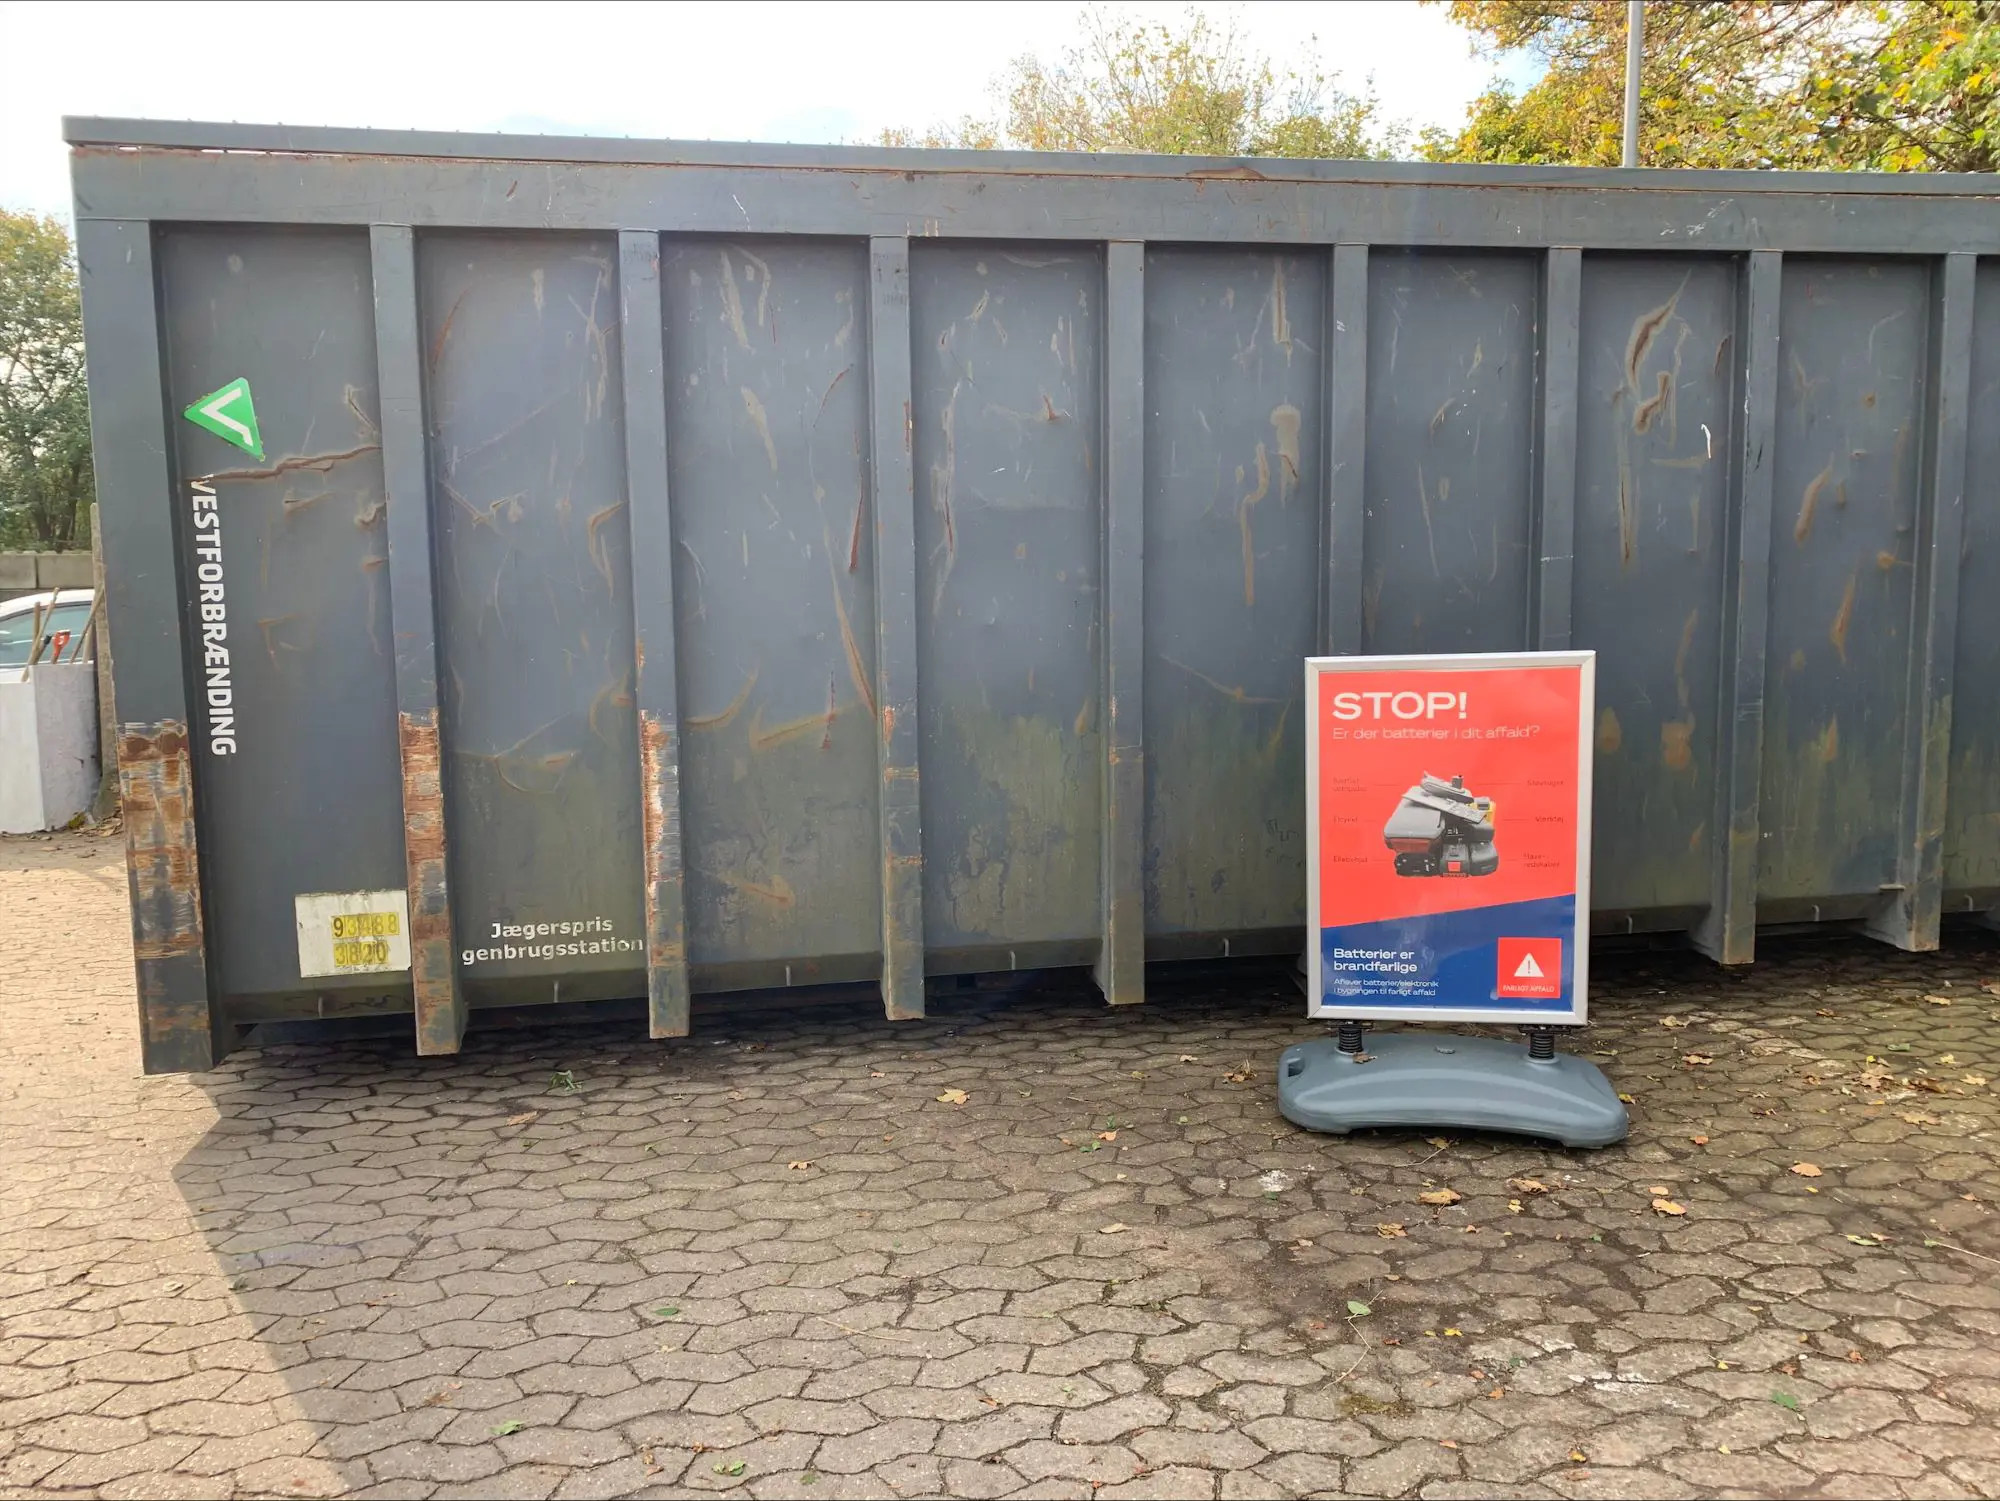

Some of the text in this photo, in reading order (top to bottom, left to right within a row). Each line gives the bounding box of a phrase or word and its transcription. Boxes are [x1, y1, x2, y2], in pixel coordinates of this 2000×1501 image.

[190, 473, 237, 756] VESTFORBRÆNDING
[1332, 691, 1468, 721] STOP!
[1332, 727, 1349, 739] Er
[1353, 727, 1377, 739] der
[1382, 727, 1449, 739] batterier
[1462, 726, 1484, 739] dit
[1486, 725, 1541, 739] affald?
[490, 916, 613, 941] Jægerspris
[461, 937, 643, 966] genbrugsstation
[1333, 948, 1415, 960] Batterier er
[1333, 961, 1418, 974] brandfarlige
